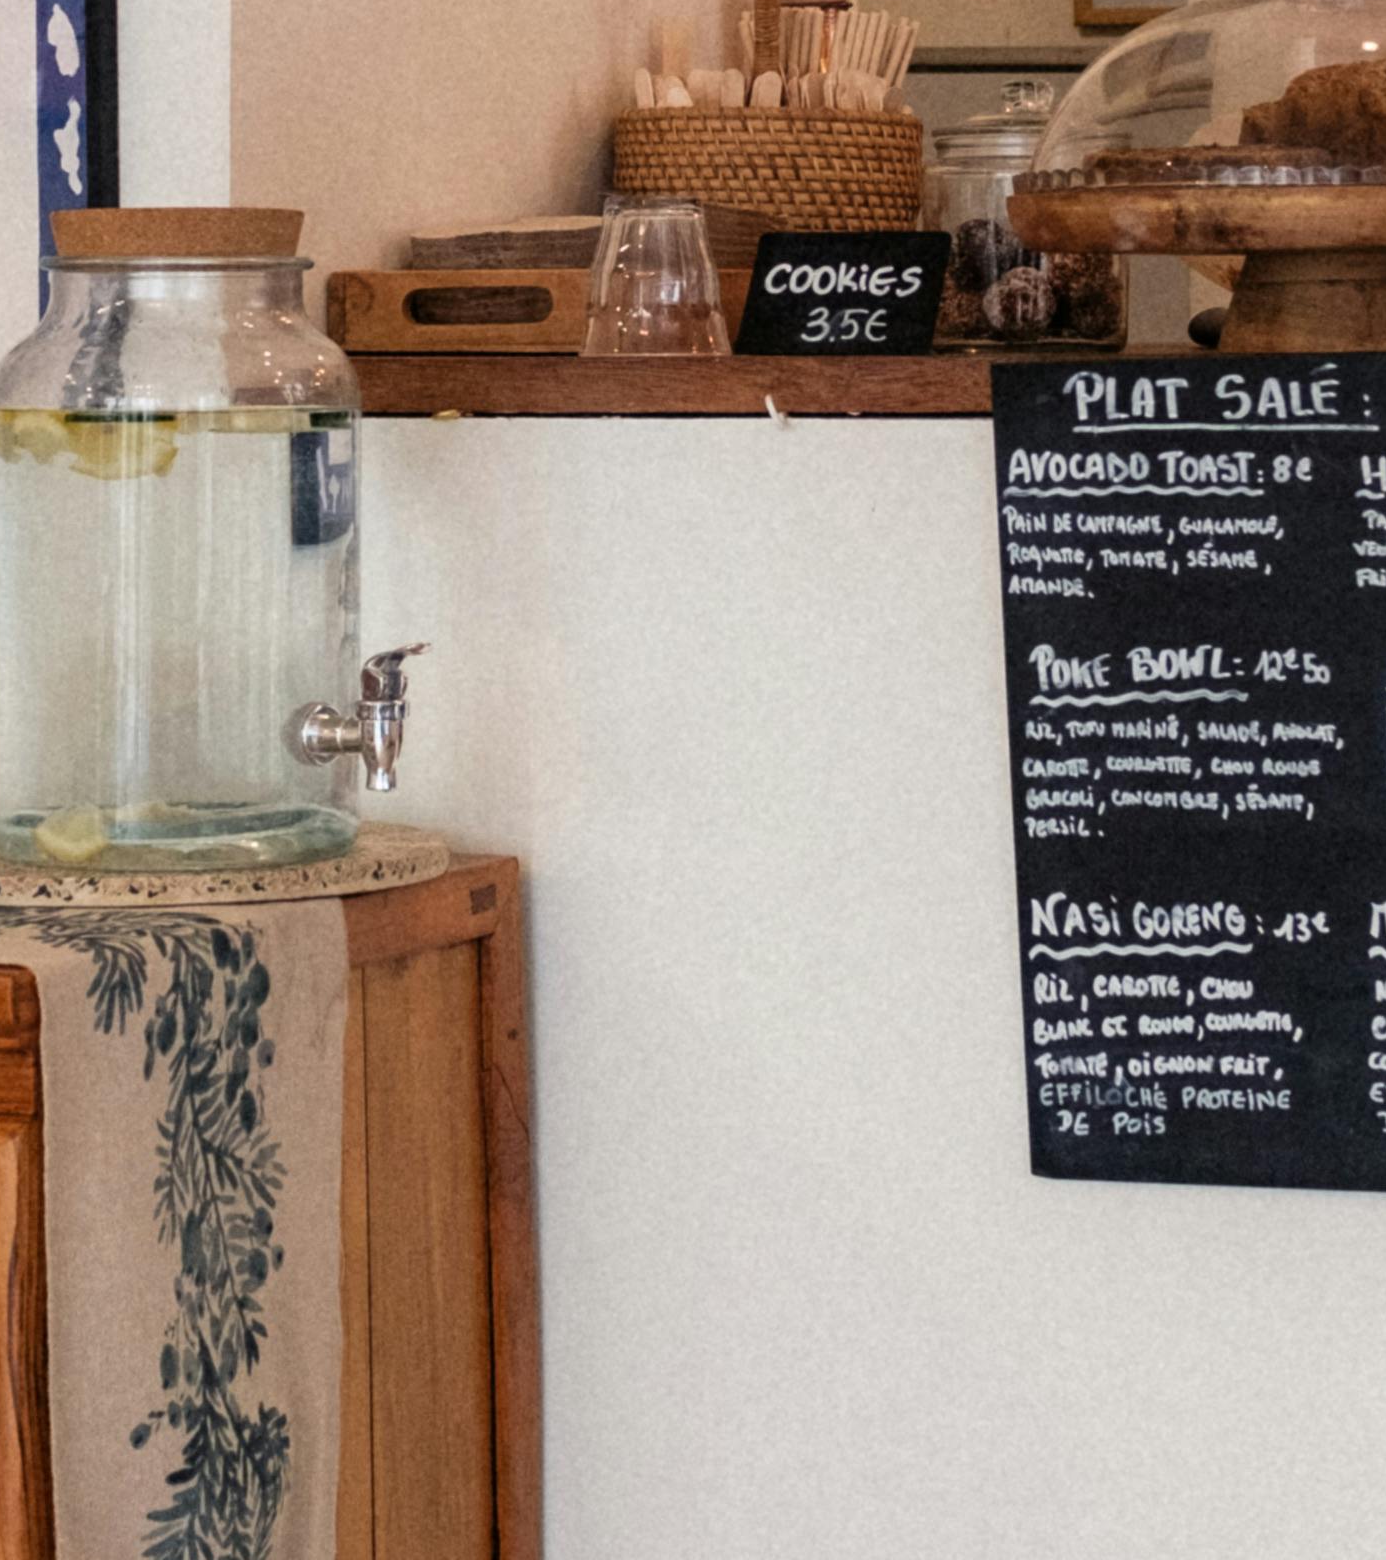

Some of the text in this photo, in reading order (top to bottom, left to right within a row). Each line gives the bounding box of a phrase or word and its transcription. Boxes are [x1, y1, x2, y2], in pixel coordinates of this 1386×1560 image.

[799, 305, 889, 346] 3.5€
[1063, 370, 1189, 421] PLAT
[1008, 448, 1151, 484] AVOCADO
[1029, 644, 1112, 691] POKE
[1200, 977, 1254, 999] CHOU
[1056, 1110, 1090, 1136] DE
